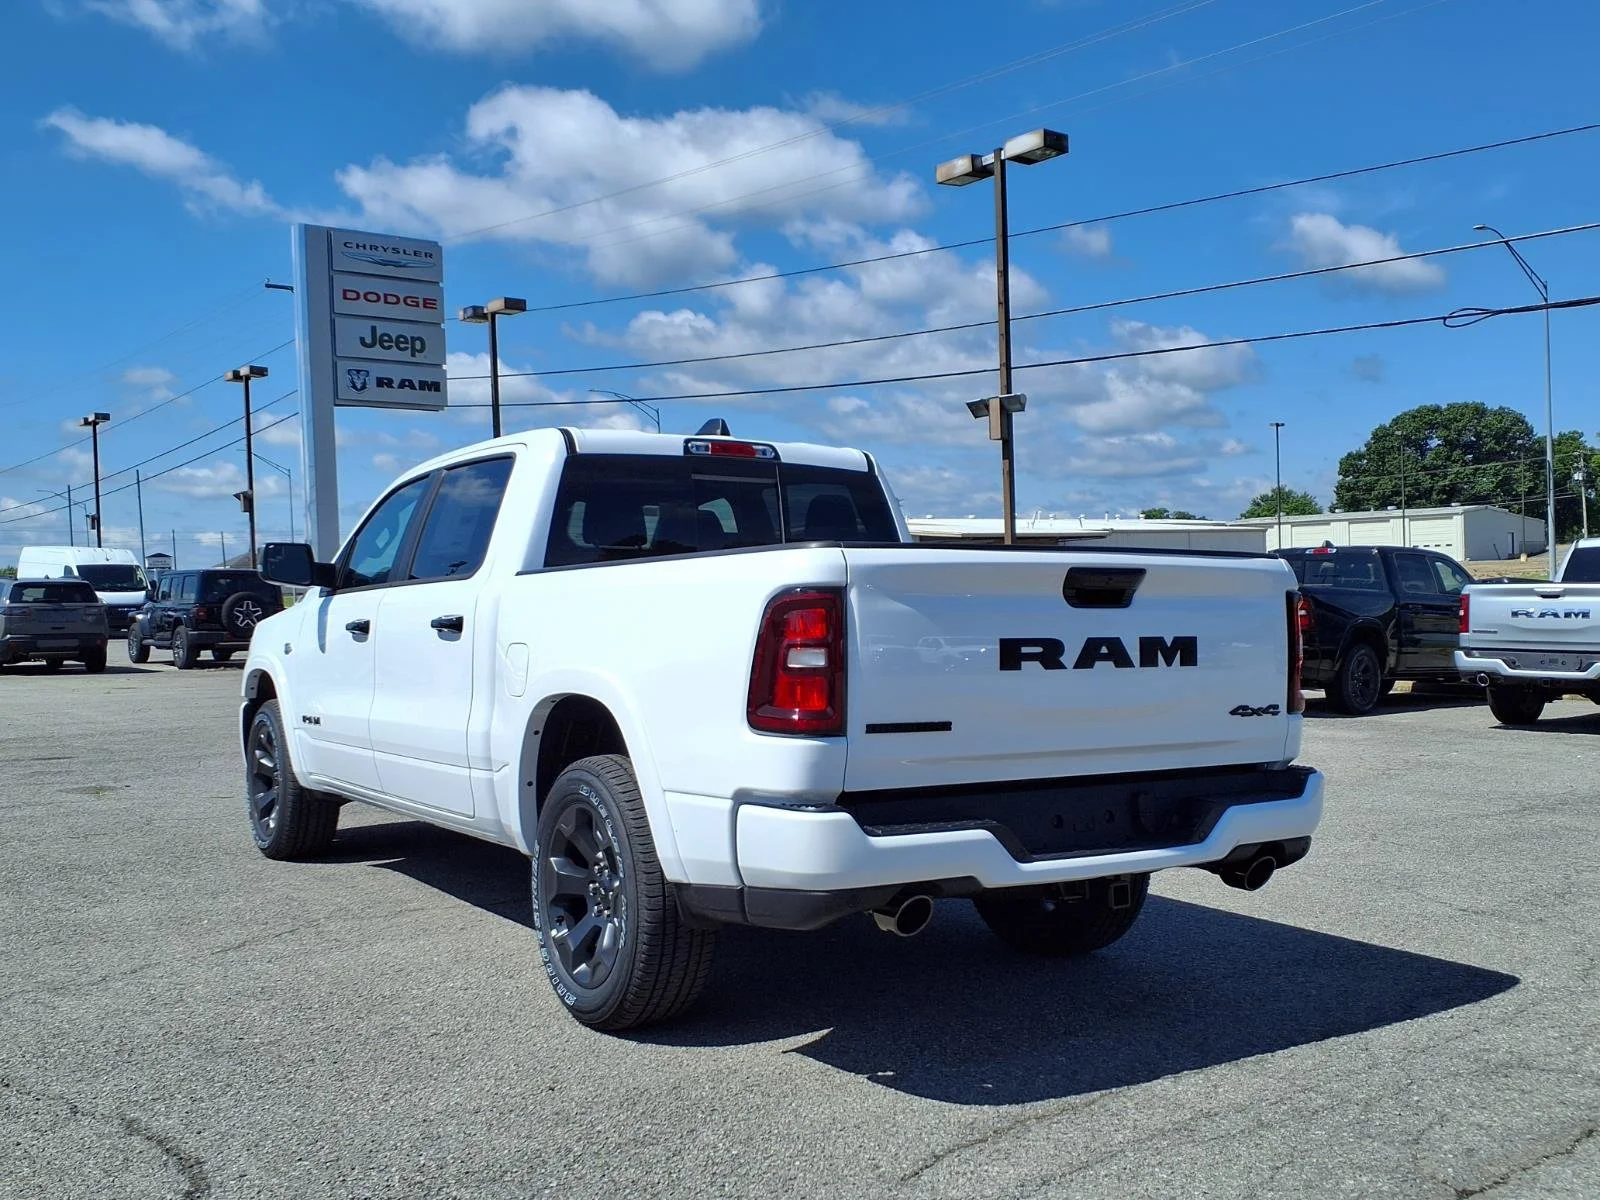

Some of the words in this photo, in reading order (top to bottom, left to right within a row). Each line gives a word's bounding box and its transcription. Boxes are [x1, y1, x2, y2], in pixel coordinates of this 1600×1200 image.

[343, 241, 433, 260] CHRYSLER
[342, 288, 438, 310] DODGE
[359, 325, 426, 357] Jeep
[375, 376, 441, 392] RAM
[1511, 607, 1591, 620] RAM
[999, 636, 1198, 671] RAM
